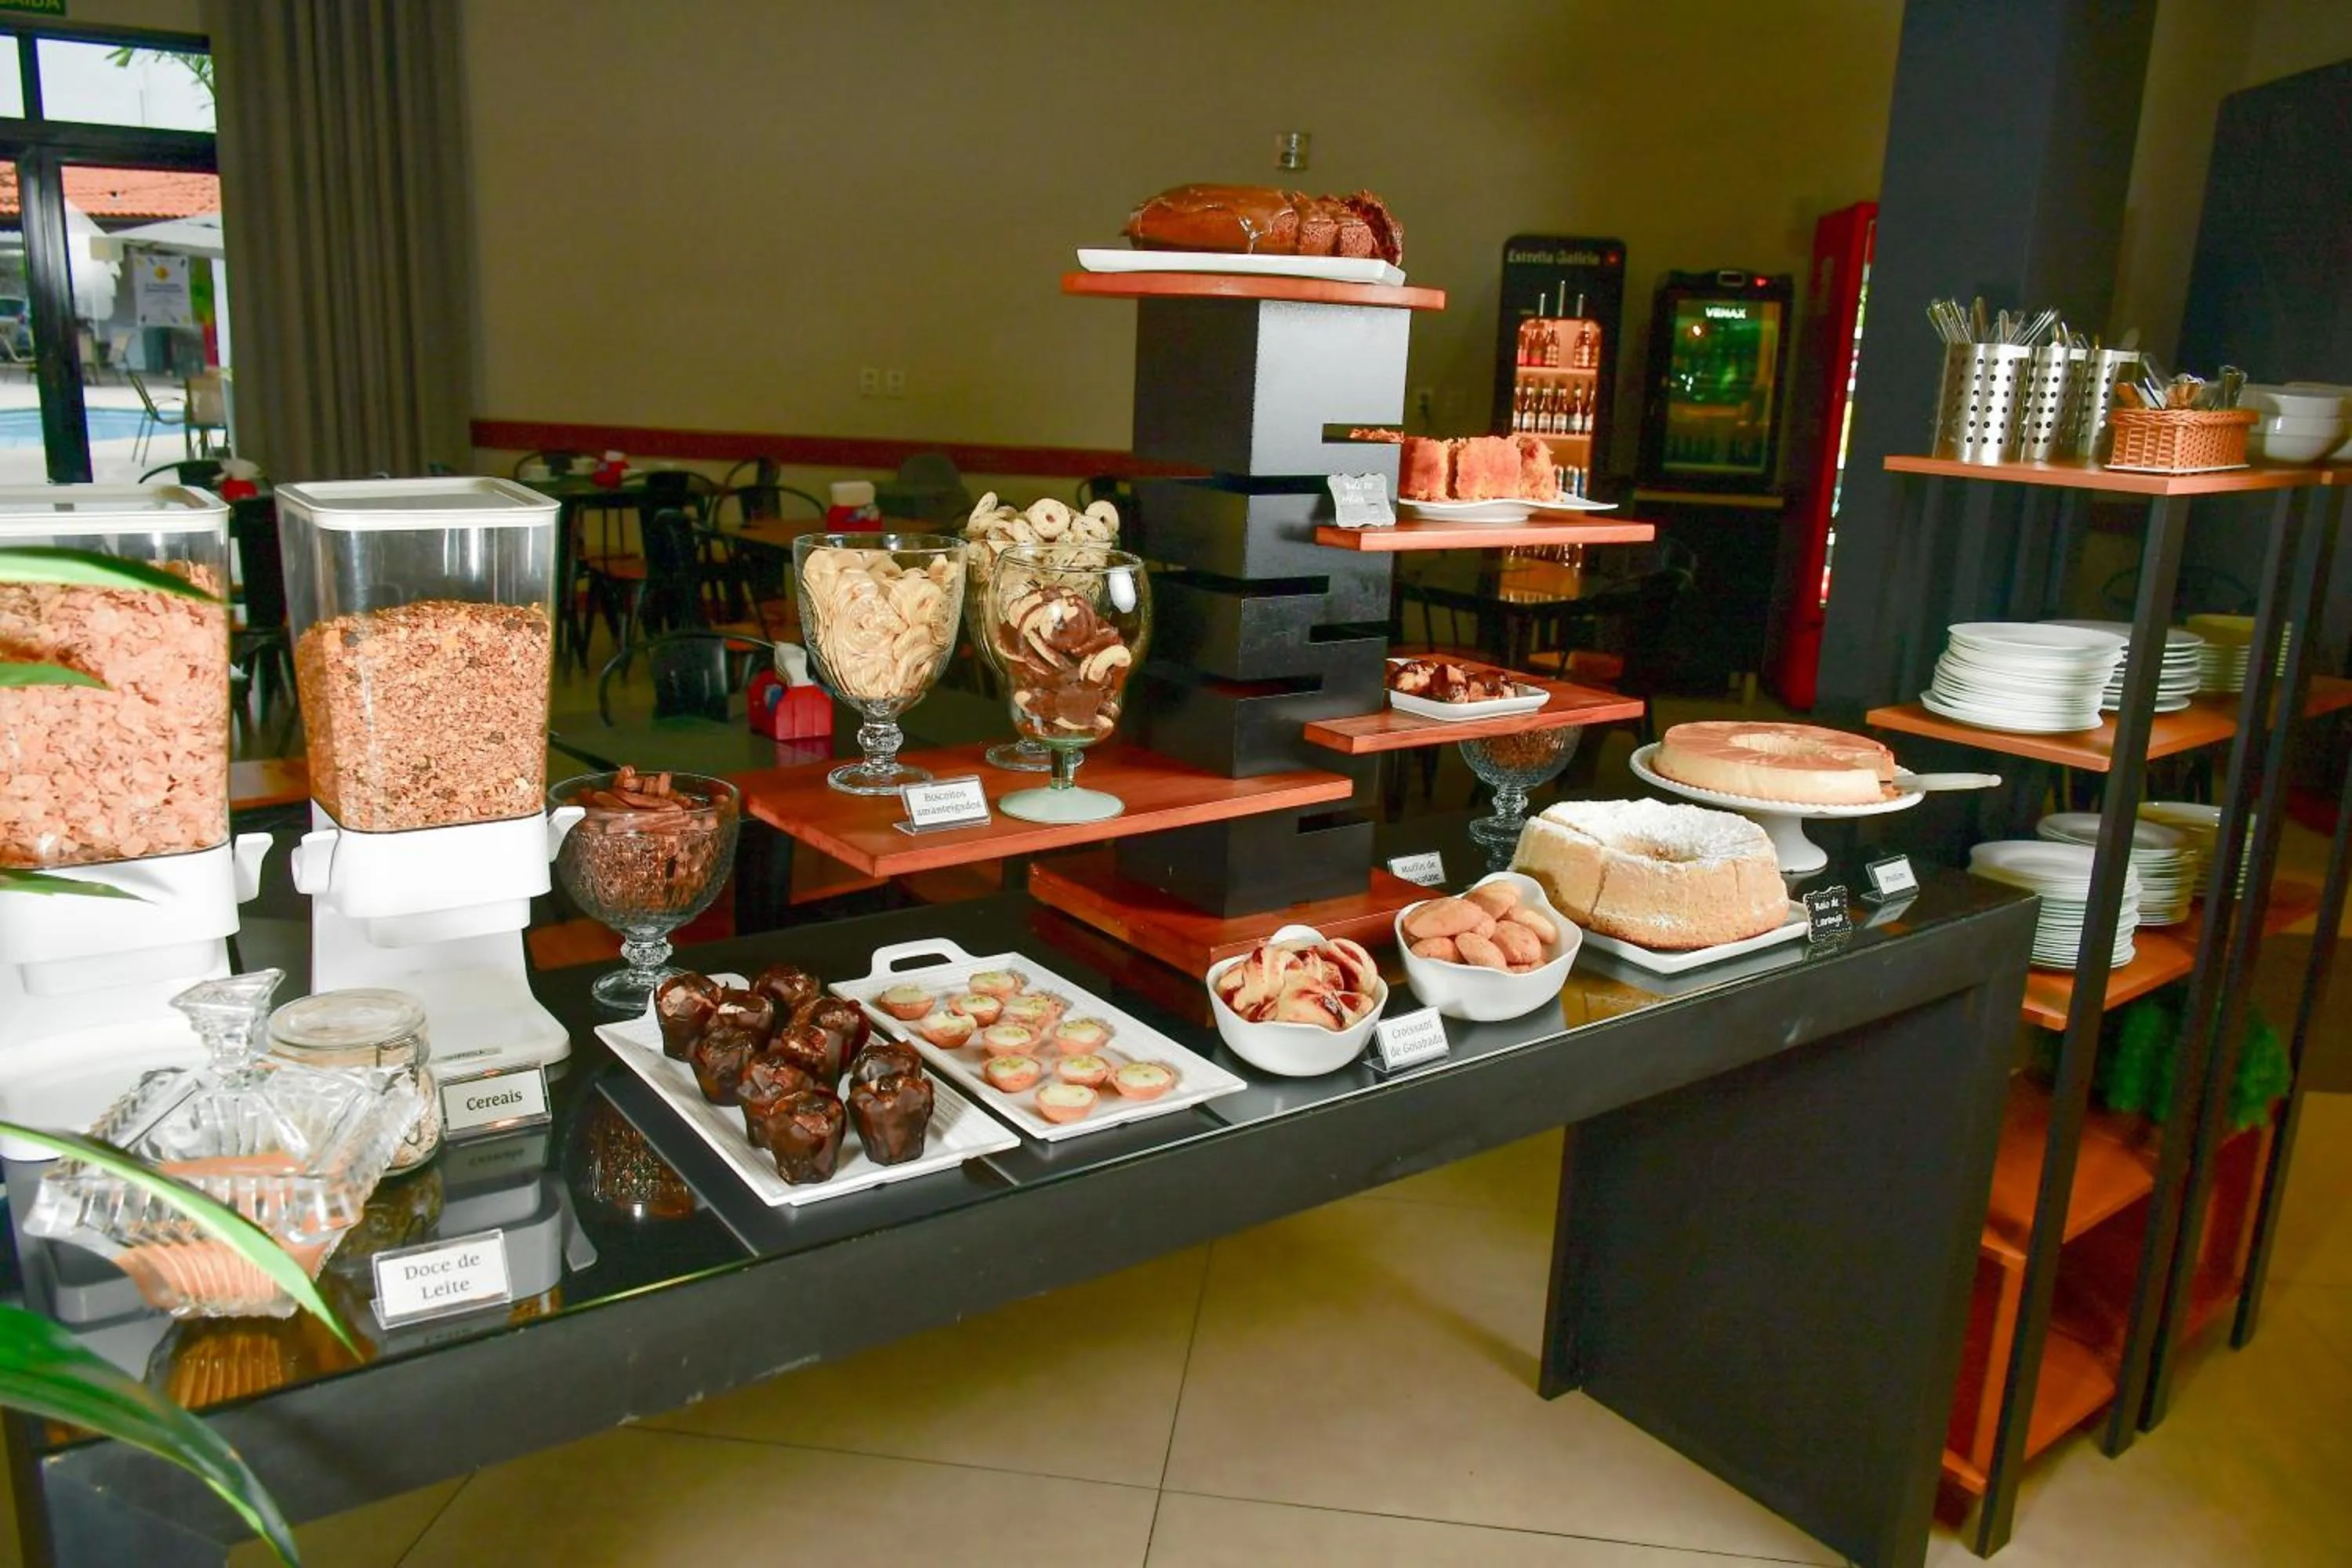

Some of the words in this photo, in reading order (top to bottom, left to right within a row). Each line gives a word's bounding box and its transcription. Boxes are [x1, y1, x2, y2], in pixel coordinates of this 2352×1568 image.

[0, 0, 60, 9] IDA
[1705, 307, 1746, 319] VENAX
[1427, 860, 1436, 869] de
[1391, 1046, 1402, 1058] de
[466, 1089, 524, 1112] Cereais
[404, 1260, 452, 1281] Doce
[457, 1254, 482, 1269] de
[421, 1279, 470, 1300] Leite
